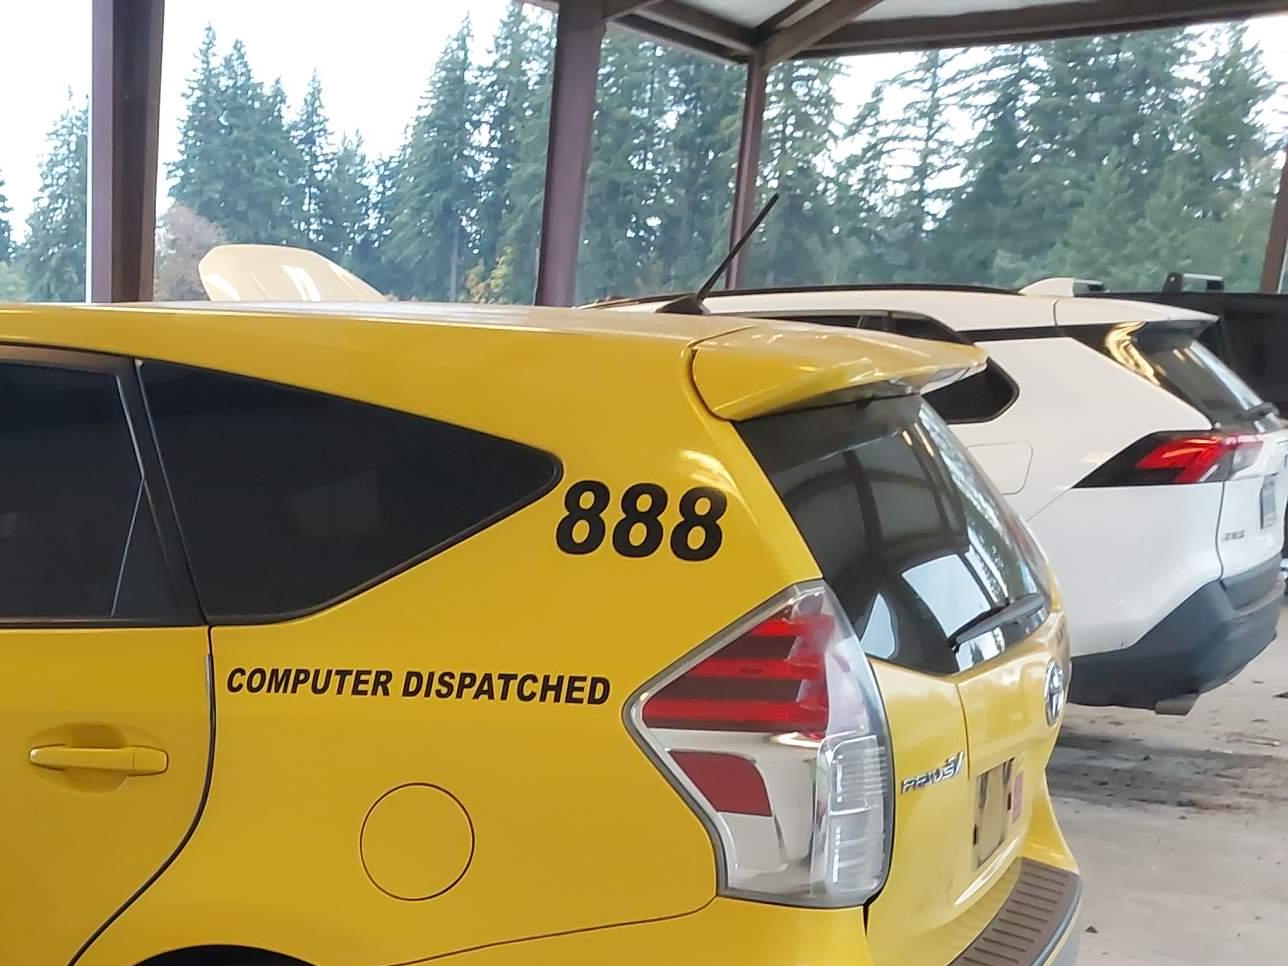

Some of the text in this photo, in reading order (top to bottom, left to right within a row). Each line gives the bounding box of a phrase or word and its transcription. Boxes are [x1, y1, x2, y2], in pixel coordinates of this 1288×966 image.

[555, 479, 727, 562] 888
[226, 667, 610, 706] COMPUTER DISPATCHED
